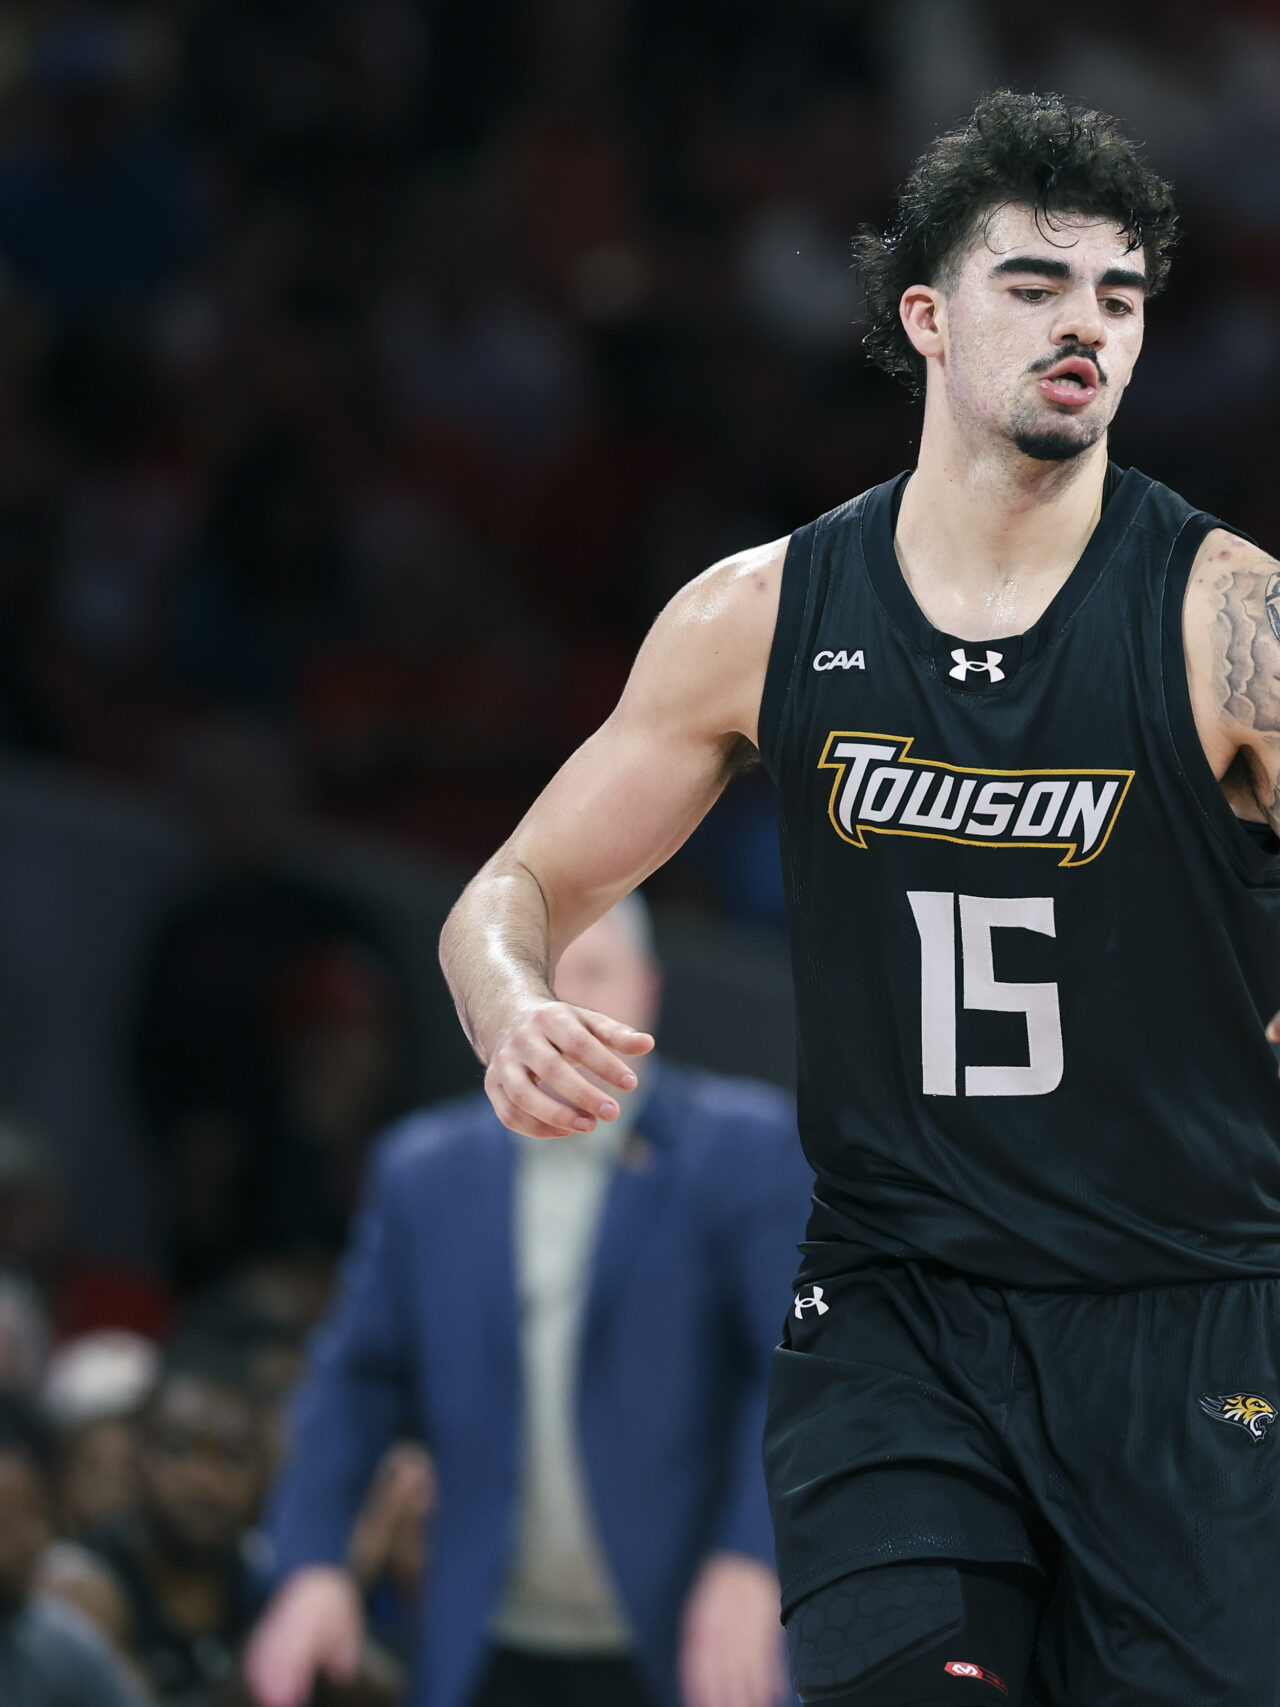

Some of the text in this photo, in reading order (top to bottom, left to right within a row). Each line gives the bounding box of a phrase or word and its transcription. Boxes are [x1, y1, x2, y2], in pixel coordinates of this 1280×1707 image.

[813, 650, 866, 671] CAA
[833, 742, 1120, 854] TOWSON
[906, 890, 1064, 1097] 15
